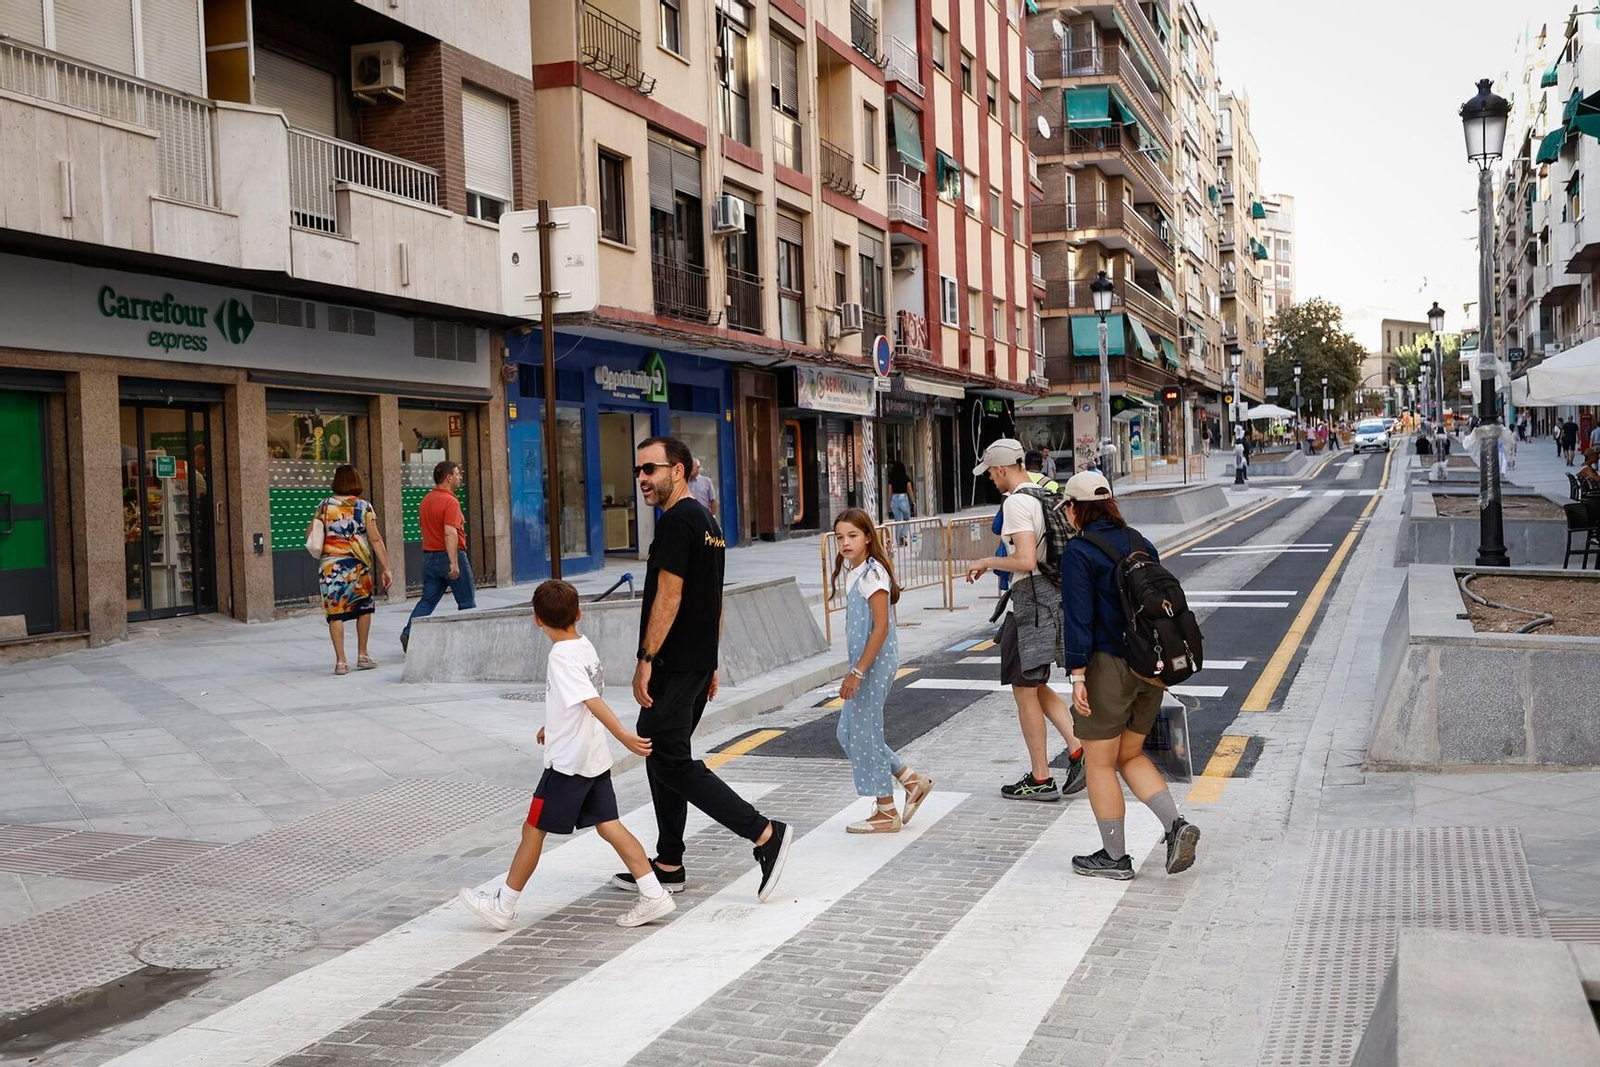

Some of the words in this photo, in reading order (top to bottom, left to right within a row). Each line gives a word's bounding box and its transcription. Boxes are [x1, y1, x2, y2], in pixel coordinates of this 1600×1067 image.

[98, 285, 208, 328] Carrefour
[148, 330, 208, 353] express
[597, 365, 653, 395] Opportunity
